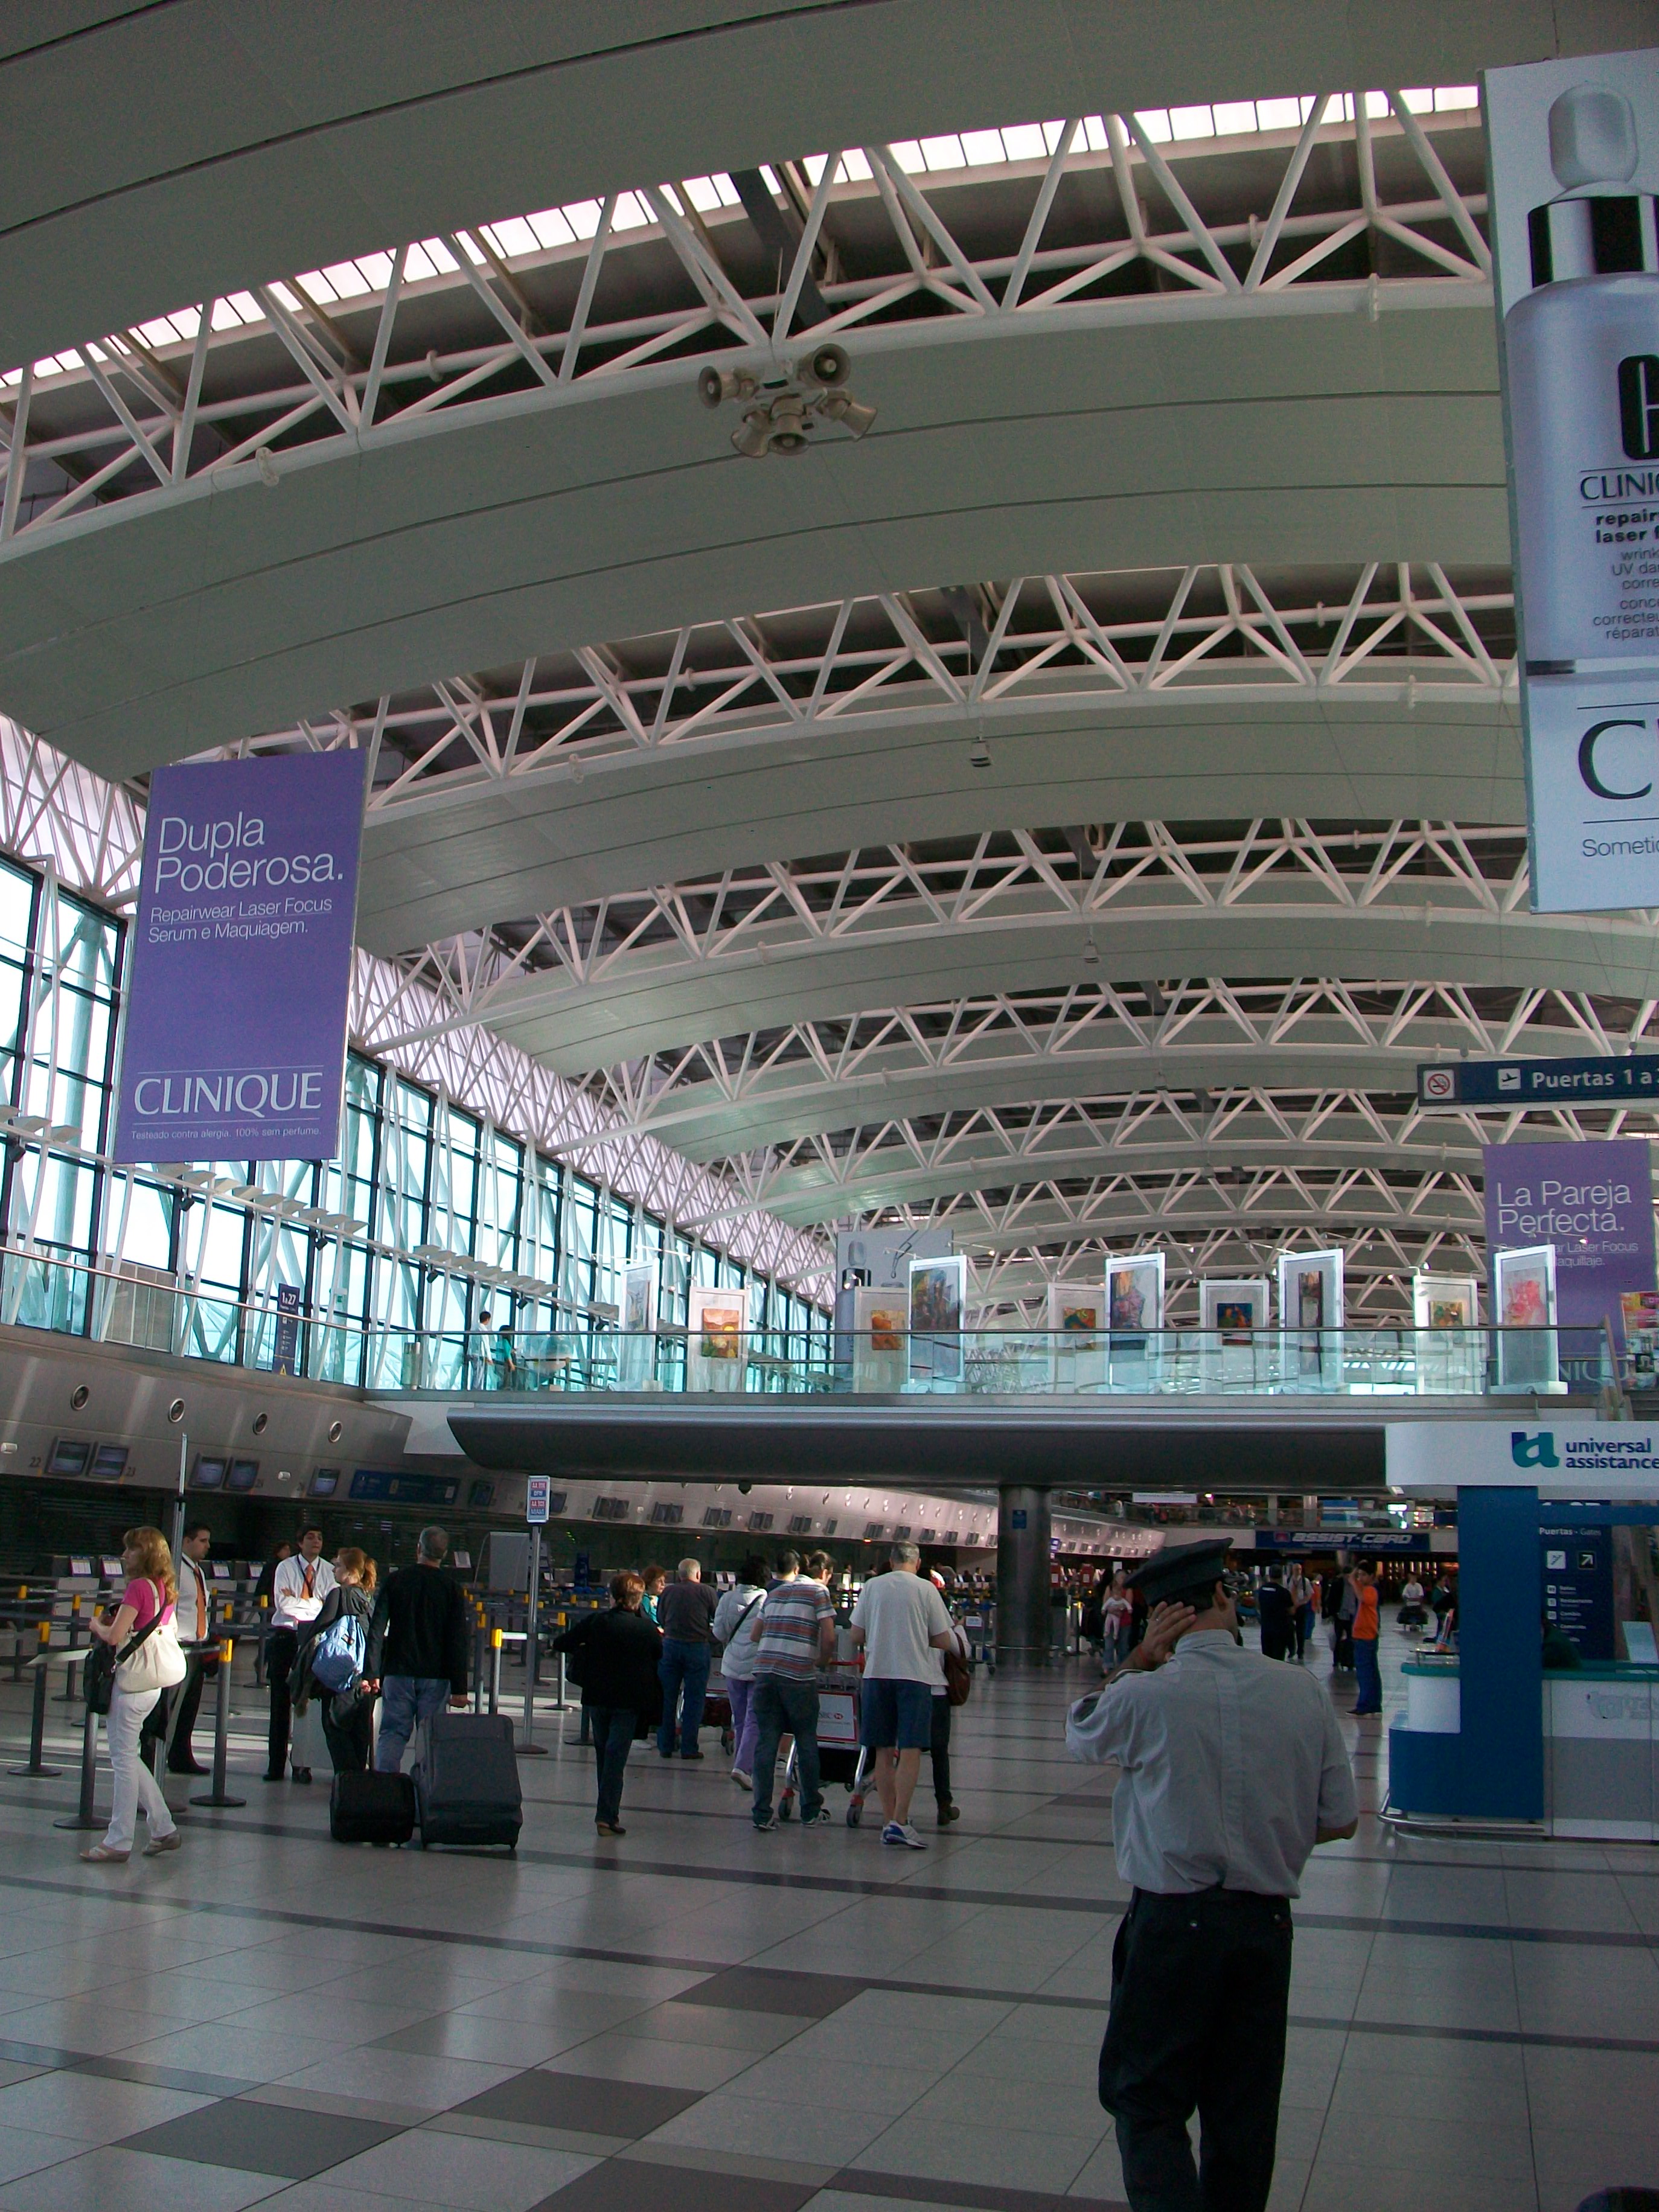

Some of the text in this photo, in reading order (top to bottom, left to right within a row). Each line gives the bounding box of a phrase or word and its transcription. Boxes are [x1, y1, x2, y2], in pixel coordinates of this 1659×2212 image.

[1581, 472, 1659, 500] CLINI
[1612, 563, 1634, 575] UV
[1578, 719, 1659, 800] C
[158, 811, 265, 858] Dupla
[154, 852, 344, 893] Poderosa.
[150, 897, 332, 924] Repairwear Laser Focus
[148, 920, 308, 942] Serum e Maquiagem.
[1532, 1071, 1614, 1088] Puertas
[1623, 1069, 1632, 1085] 1
[1640, 1071, 1652, 1084] a
[134, 1071, 323, 1118] CLINIQUE
[171, 1129, 199, 1139] contra
[200, 1128, 232, 1139] alergia.
[235, 1127, 259, 1137] 100%
[262, 1128, 280, 1137] sem
[283, 1126, 322, 1138] perfume.
[1496, 1180, 1632, 1210] La Pareja
[1498, 1208, 1625, 1235] Perfecta.
[1567, 1241, 1599, 1253] Laser
[1602, 1241, 1638, 1252] Focus
[1555, 1256, 1605, 1268] aquillaje.
[1565, 1437, 1652, 1453] universal
[1565, 1453, 1659, 1469] assistance
[1539, 1527, 1573, 1536] Puertas
